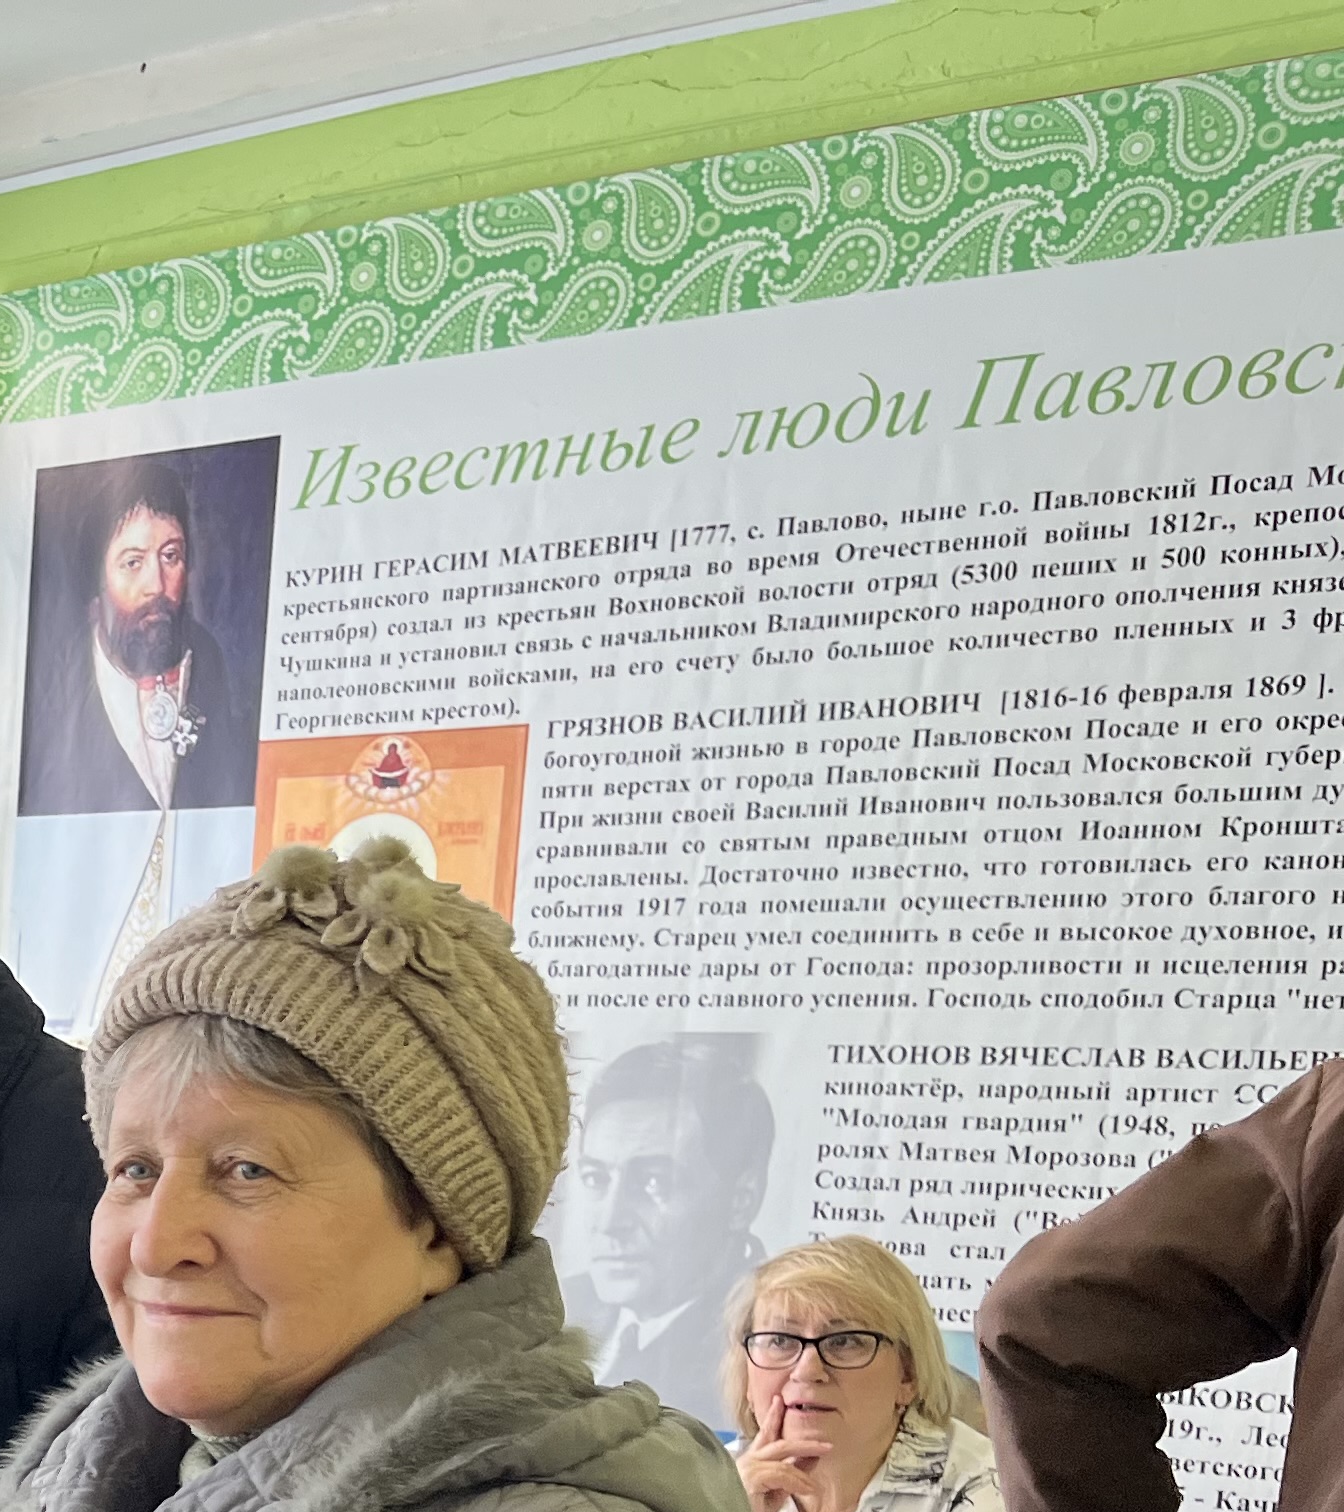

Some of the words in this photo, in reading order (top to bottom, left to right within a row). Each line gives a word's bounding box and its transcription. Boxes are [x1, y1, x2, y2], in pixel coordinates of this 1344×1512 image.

[291, 416, 701, 511] Известные
[717, 371, 932, 458] люди
[286, 563, 363, 588] КУРИН
[373, 549, 488, 580] ГЕРАСИМ
[499, 531, 659, 567] МАТВЕЕВИЧ
[670, 523, 737, 553] [1777,
[747, 525, 765, 540] с.
[777, 512, 889, 537] Павлово,
[900, 503, 967, 525] ныне
[978, 499, 1019, 517] г.о.
[1032, 477, 1197, 512] Павловский
[1209, 473, 1294, 497] Посад
[283, 590, 430, 621] крестьянского
[442, 573, 601, 605] партизанского
[613, 563, 692, 588] отряда
[706, 559, 733, 576] во
[747, 551, 820, 577] время
[835, 525, 1028, 564] Отечественной
[1044, 520, 1131, 545] войны
[1149, 510, 1236, 536] 1812г.,
[281, 620, 378, 646] сентября)
[387, 618, 453, 636] создал
[464, 614, 486, 630] из
[497, 604, 596, 631] крестьян
[608, 585, 745, 617] Вохновской
[758, 580, 854, 603] волости
[867, 572, 938, 597] отряд
[951, 560, 1018, 591] (5300
[1031, 557, 1117, 580] пеших
[1130, 555, 1147, 572] и
[1160, 545, 1206, 570] 500
[280, 654, 372, 678] Чушкина
[380, 652, 392, 666] и
[398, 642, 507, 670] установил
[514, 637, 574, 655] связь
[581, 635, 593, 650] с
[600, 620, 757, 648] начальником
[767, 603, 961, 634] Владимирского
[970, 592, 1105, 621] народного
[1115, 581, 1262, 607] ополчения
[277, 676, 456, 702] наполеоновскими
[468, 667, 578, 689] войсками,
[590, 663, 616, 680] на
[628, 660, 664, 676] его
[675, 653, 740, 674] счету
[751, 646, 814, 667] было
[827, 638, 935, 661] большое
[948, 627, 1099, 652] количество
[1113, 618, 1235, 641] пленных
[1249, 616, 1266, 633] и
[1281, 608, 1297, 631] 3
[276, 709, 415, 733] Георгиевским
[422, 697, 521, 725] крестом).
[547, 713, 663, 739] ГРЯЗНОВ
[673, 698, 807, 731] ВАСИЛИЙ
[818, 692, 980, 722] ИВАНОВИЧ
[1000, 684, 1108, 716] [1816-16
[1117, 683, 1233, 710] февраля
[1245, 673, 1307, 698] 1869
[543, 743, 682, 772] богоугодной
[691, 741, 785, 761] жизнью
[795, 740, 809, 755] в
[820, 735, 901, 758] городе
[911, 726, 1072, 749] Павловском
[1085, 718, 1180, 740] Посаде
[1191, 719, 1208, 735] и
[1220, 716, 1263, 734] его
[541, 783, 593, 800] пяти
[603, 779, 690, 801] верстах
[700, 776, 727, 792] от
[735, 772, 814, 794] города
[825, 758, 980, 786] Павловский
[993, 756, 1071, 778] Посад
[1082, 746, 1252, 774] Московской
[539, 810, 584, 834] При
[592, 810, 663, 827] жизни
[671, 802, 735, 824] своей
[745, 797, 848, 821] Василий
[858, 795, 986, 816] Иванович
[996, 789, 1163, 811] пользовался
[1174, 783, 1303, 805] большим
[535, 841, 668, 864] сравнивали
[681, 839, 706, 855] со
[719, 835, 810, 853] святым
[825, 830, 968, 855] праведным
[983, 827, 1063, 845] отцом
[1080, 820, 1202, 841] Иоанном
[534, 871, 689, 894] прославлены.
[698, 865, 839, 887] Достаточно
[851, 862, 969, 880] известно,
[983, 860, 1027, 877] что
[1040, 857, 1192, 876] готовилась
[1206, 856, 1249, 872] его
[530, 900, 623, 919] события
[638, 897, 687, 917] 1917
[698, 900, 747, 917] года
[760, 897, 886, 914] помешали
[900, 892, 1107, 917] осуществлению
[1121, 891, 1194, 908] этого
[1208, 885, 1316, 907] благого
[528, 930, 645, 953] ближнему.
[653, 928, 737, 952] Старец
[743, 930, 802, 951] умел
[811, 928, 939, 946] соединить
[948, 928, 962, 943] в
[971, 921, 1025, 943] себе
[1034, 927, 1049, 942] и
[1059, 925, 1174, 942] высокое
[1180, 924, 1316, 944] духовное,
[547, 959, 691, 979] благодатные
[699, 962, 759, 983] дары
[769, 962, 797, 977] от
[806, 956, 914, 977] Господа:
[926, 959, 1123, 981] прозорливости
[1134, 959, 1150, 975] и
[1162, 959, 1308, 977] исцеления
[587, 994, 649, 1008] после
[655, 994, 691, 1008] его
[697, 993, 804, 1008] славного
[811, 993, 918, 1013] успения.
[927, 987, 1032, 1010] Господь
[1040, 988, 1164, 1010] сподобил
[1173, 987, 1276, 1015] Старца
[827, 1044, 971, 1066] ТИХОНОВ
[980, 1046, 1146, 1068] ВЯЧЕСЛАВ
[824, 1077, 964, 1104] киноактёр,
[978, 1080, 1111, 1105] народный
[1125, 1086, 1219, 1108] артист
[822, 1107, 948, 1131] "Молодая
[961, 1112, 1083, 1137] гвардия"
[1098, 1114, 1175, 1140] (1948,
[817, 1143, 889, 1163] ролях
[899, 1141, 996, 1164] Матвея
[1006, 1144, 1136, 1171] Морозова
[814, 1169, 901, 1192] Создал
[909, 1178, 953, 1198] ряд
[812, 1200, 885, 1223] Князь
[901, 1205, 996, 1232] Андрей
[949, 1244, 1005, 1261] стал
